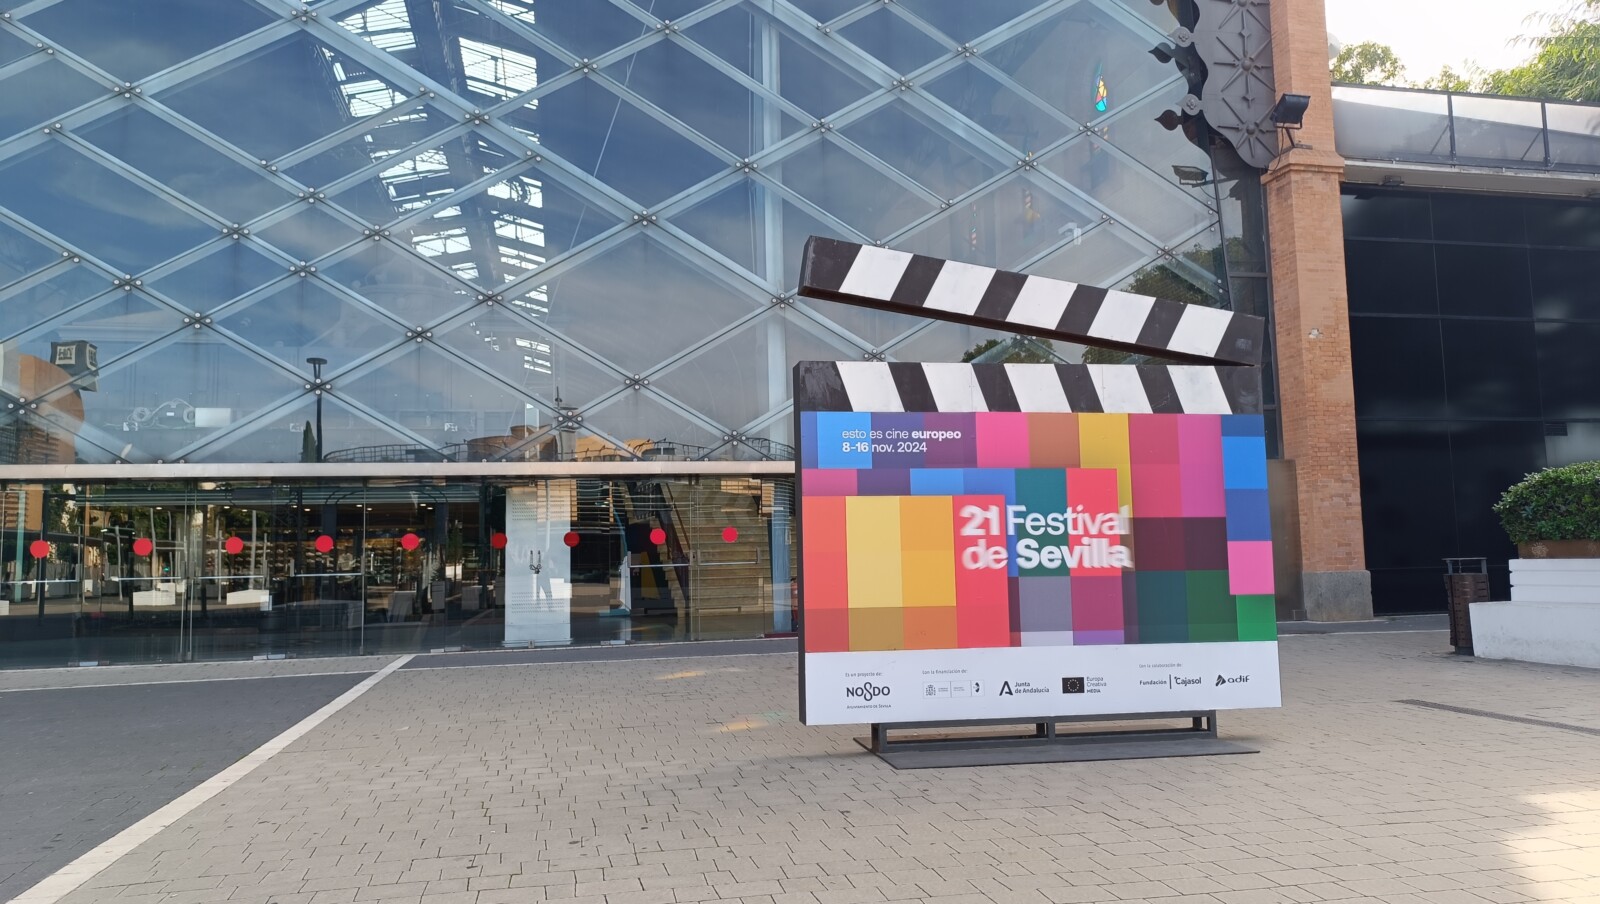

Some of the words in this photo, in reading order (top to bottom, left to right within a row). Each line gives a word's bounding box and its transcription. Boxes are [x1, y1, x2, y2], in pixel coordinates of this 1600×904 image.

[842, 429, 866, 440] esto
[869, 430, 883, 440] es
[885, 428, 909, 440] cine
[911, 429, 962, 442] europeo
[842, 442, 869, 453] 8-16
[871, 443, 895, 453] nov.
[897, 442, 928, 453] 2024
[959, 504, 999, 536] 21
[1006, 504, 1131, 536] Festival
[961, 538, 1009, 571] de
[1015, 536, 1135, 571] Sevilla
[1174, 676, 1202, 687] Cajasol
[1227, 674, 1250, 684] adif
[1022, 686, 1050, 694] Andalucía
